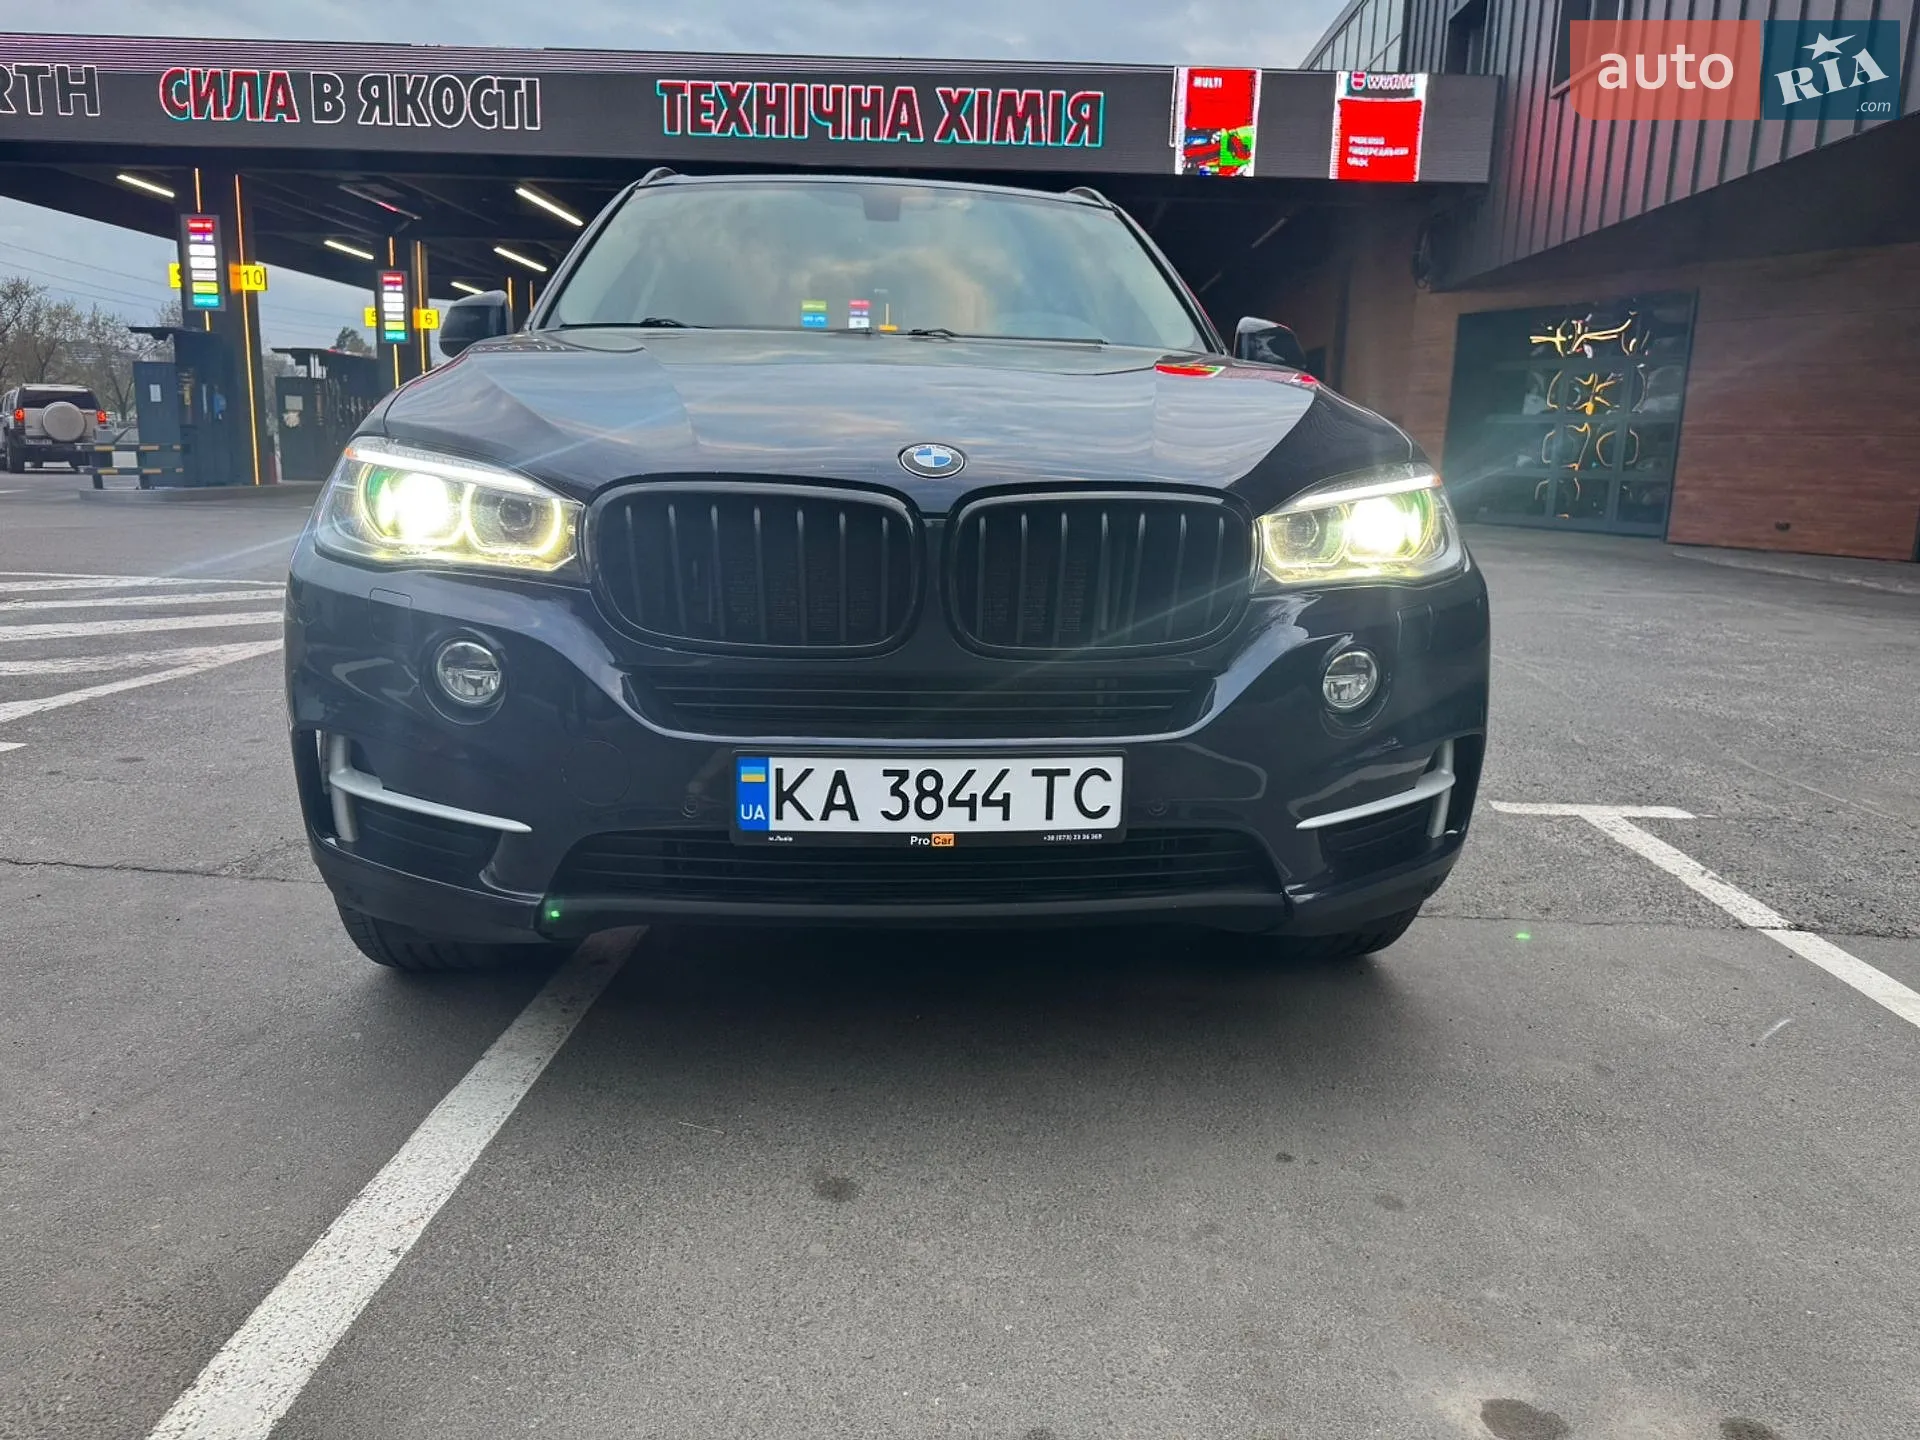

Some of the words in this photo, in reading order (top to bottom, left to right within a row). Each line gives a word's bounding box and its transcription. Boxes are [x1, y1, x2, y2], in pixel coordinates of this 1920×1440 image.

[159, 67, 300, 122] СИЛА
[310, 72, 346, 123] В
[357, 73, 541, 130] ЯКОСТІ
[656, 80, 923, 143] ТЕХНІЧНА
[933, 87, 1104, 147] ХІМІЯ
[243, 269, 263, 285] 10
[424, 312, 433, 325] 6
[741, 804, 766, 820] UA
[775, 768, 859, 821] KA
[880, 768, 1011, 822] 3844
[1031, 767, 1112, 821] TC
